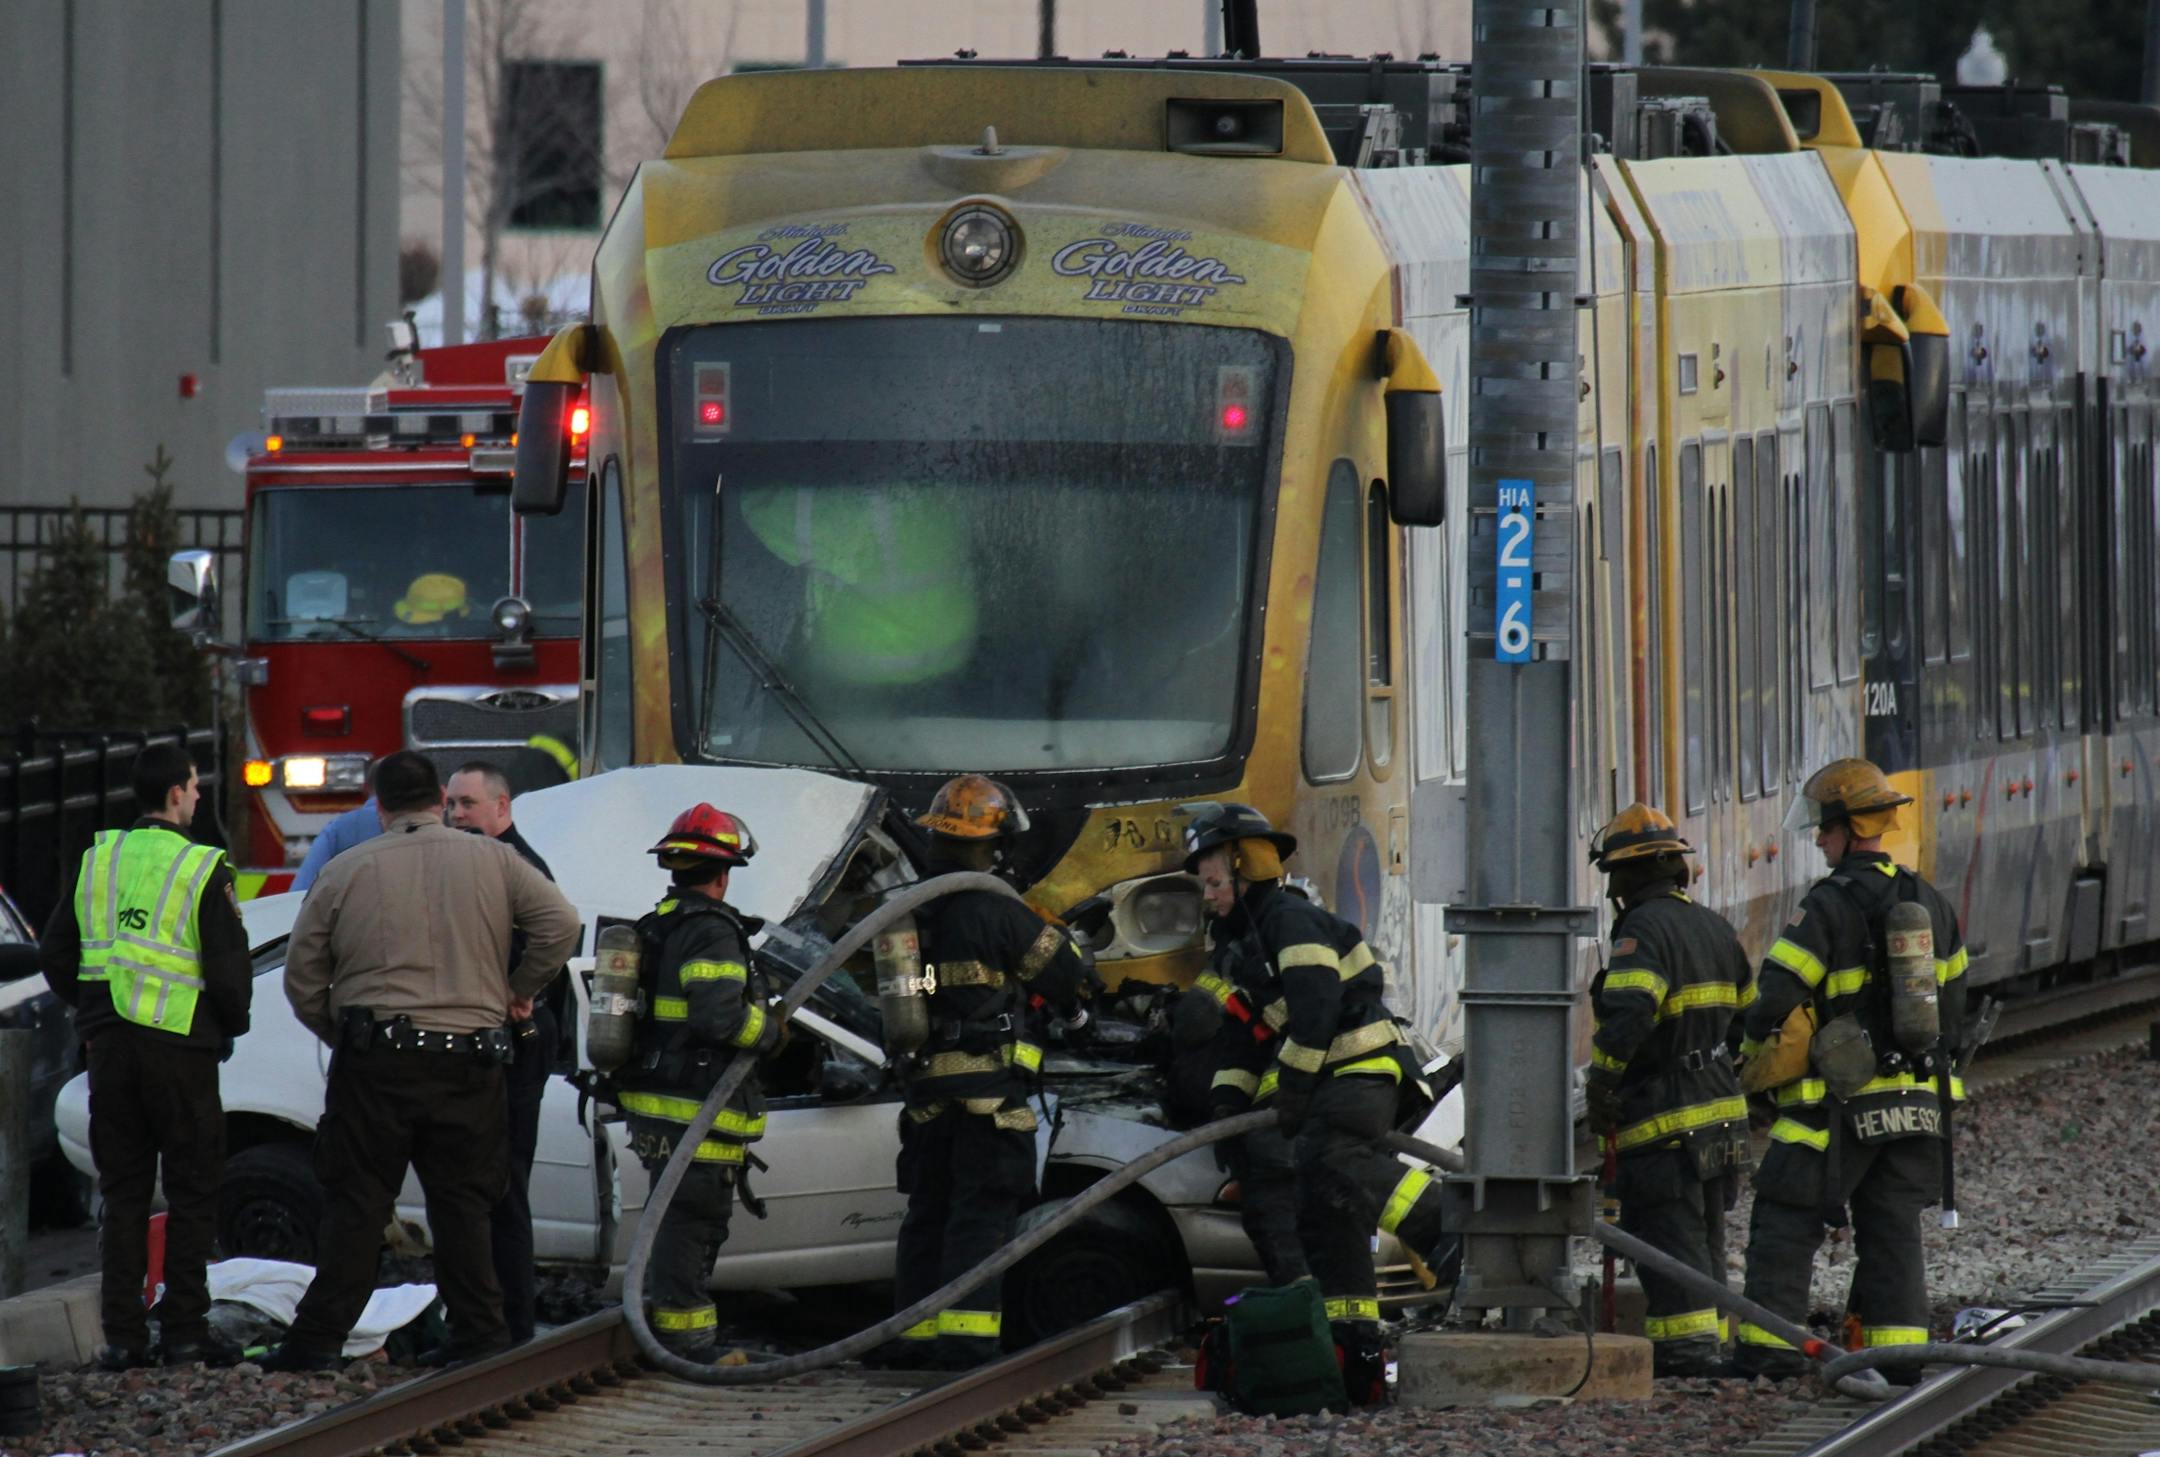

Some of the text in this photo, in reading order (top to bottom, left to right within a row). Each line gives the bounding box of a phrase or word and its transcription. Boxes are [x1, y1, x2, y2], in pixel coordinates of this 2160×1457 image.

[707, 237, 895, 286] Golden
[1052, 238, 1246, 285] Golden
[734, 279, 867, 306] LIGHT
[1084, 278, 1217, 305] LIGHT
[1499, 488, 1531, 507] HIA
[1863, 682, 1897, 716] 120A
[1853, 1106, 1942, 1140] HENNESSY
